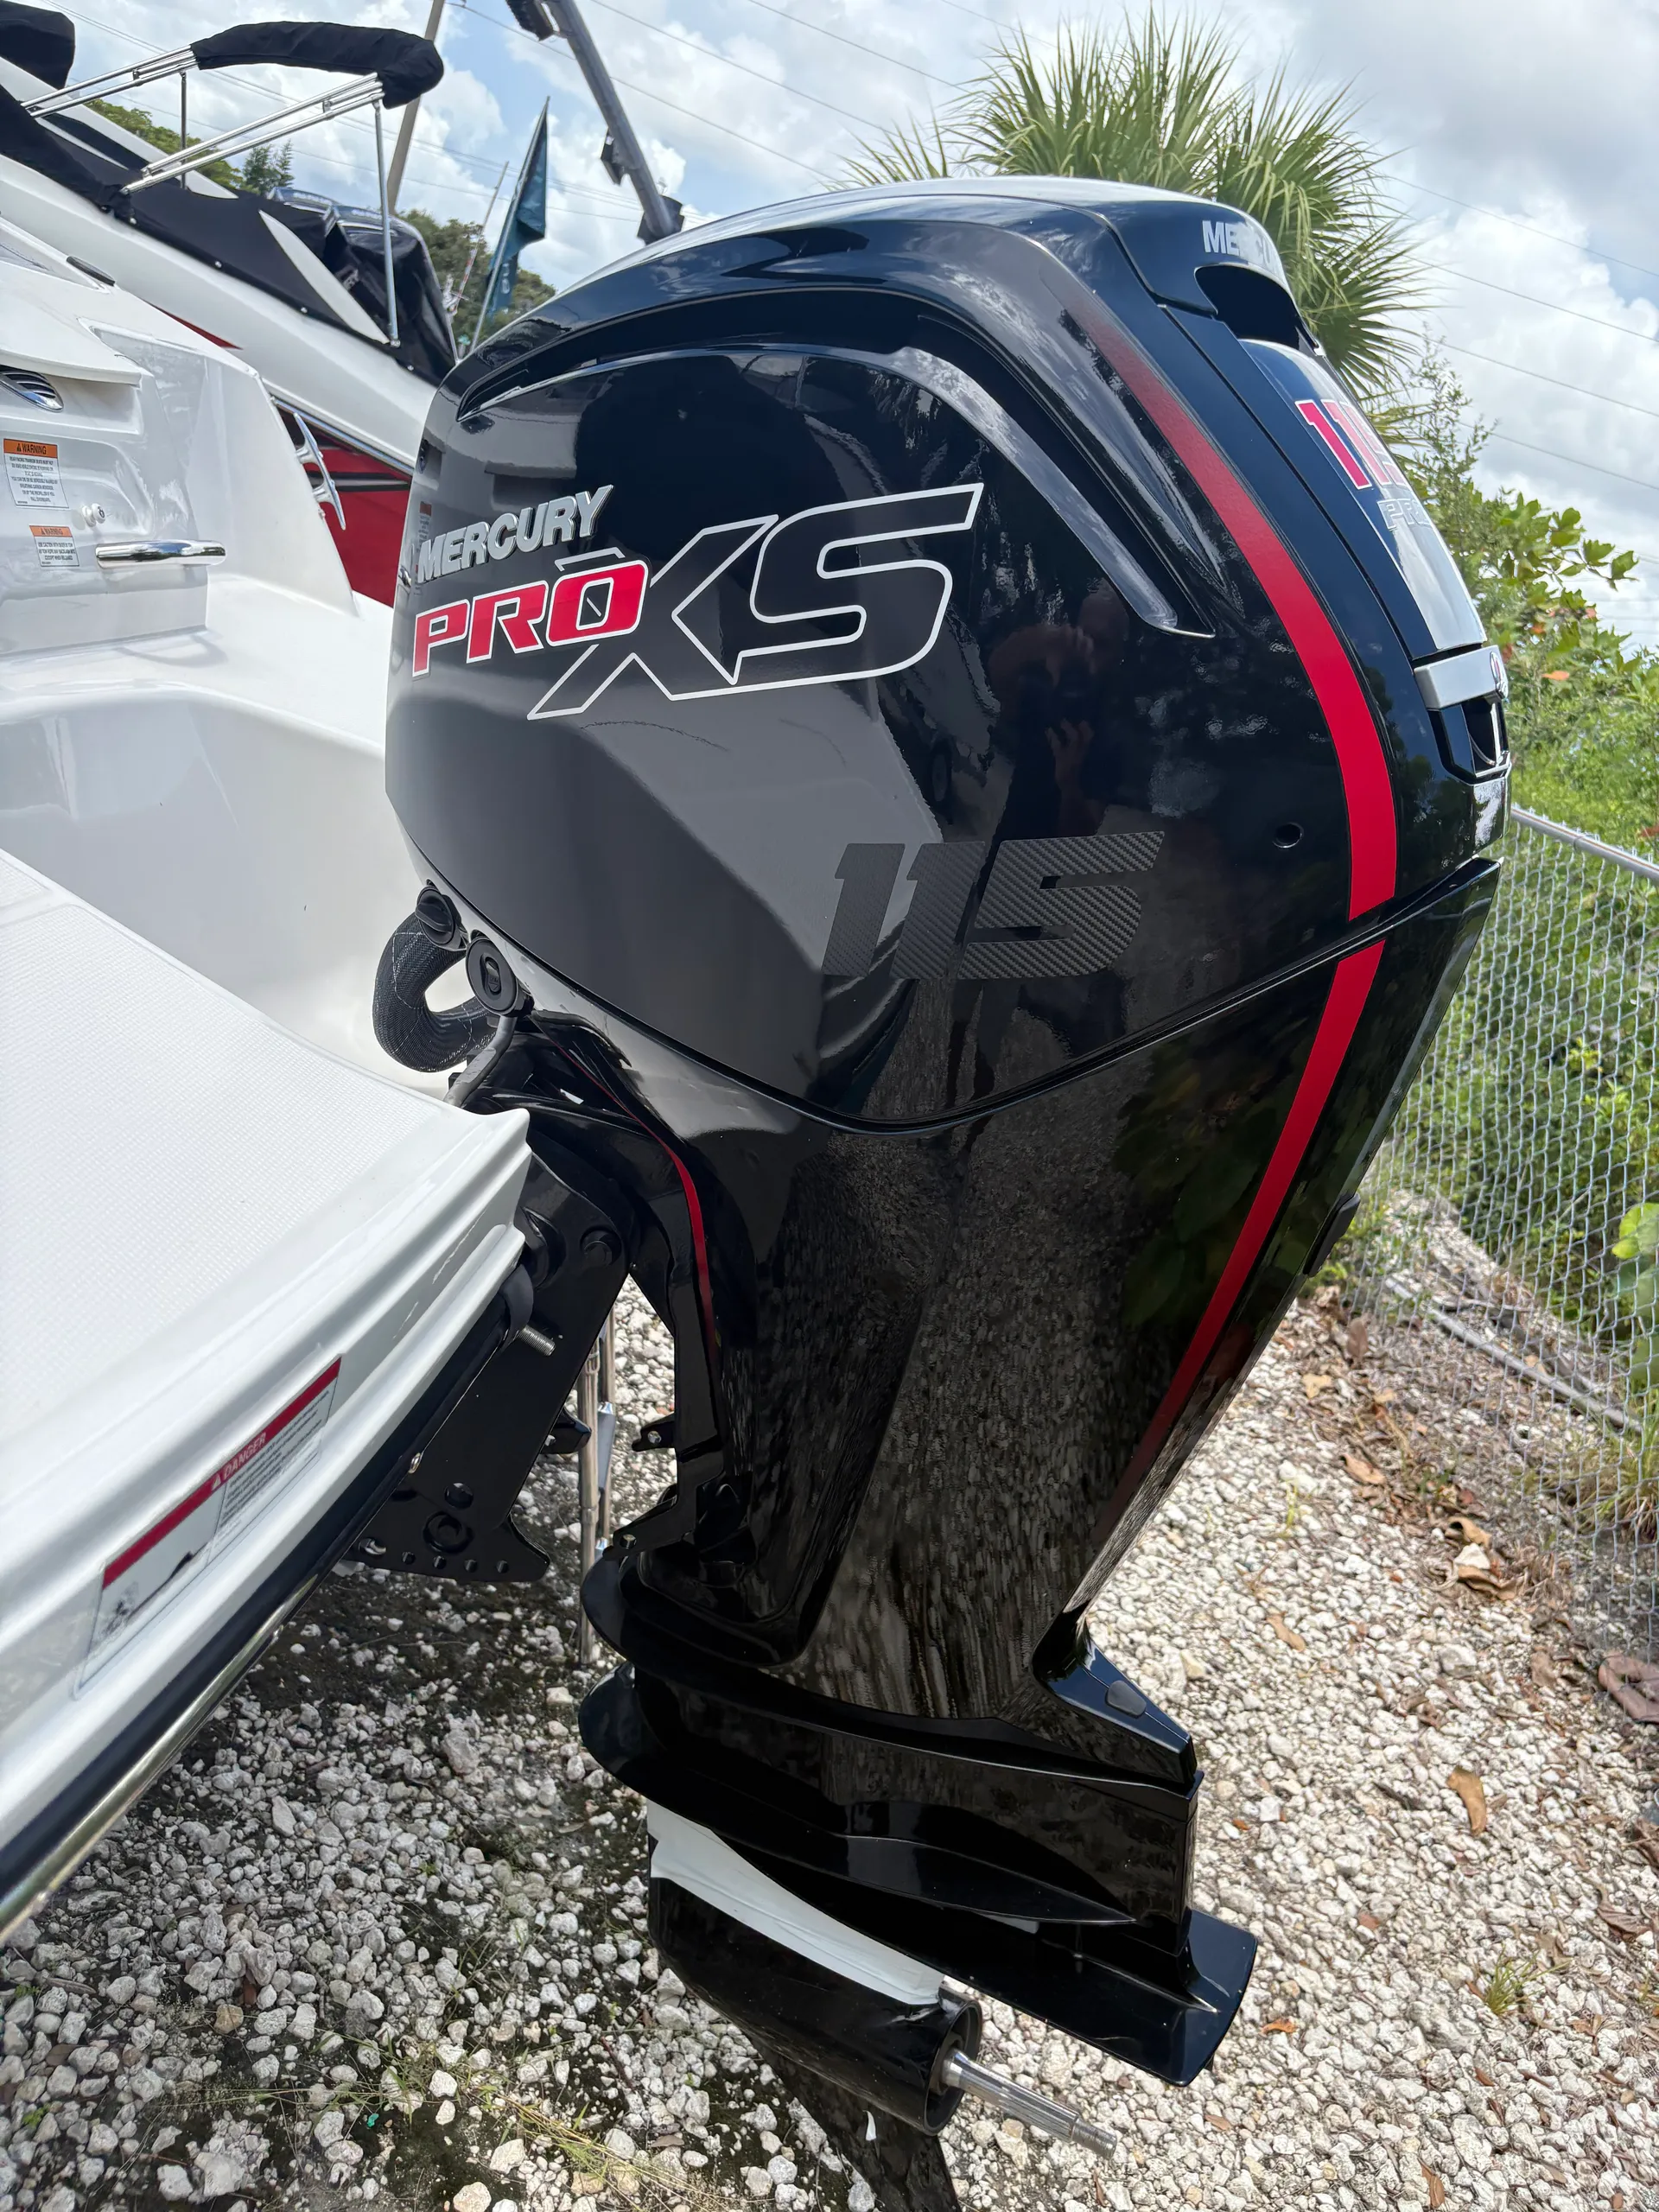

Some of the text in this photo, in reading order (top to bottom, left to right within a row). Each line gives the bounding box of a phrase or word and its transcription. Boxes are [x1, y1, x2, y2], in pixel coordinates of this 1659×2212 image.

[22, 442, 47, 455] WARNING
[416, 484, 615, 584] MERCURY
[411, 558, 649, 679] PRO
[821, 830, 1165, 981] 115
[224, 1432, 267, 1481] DANGER
